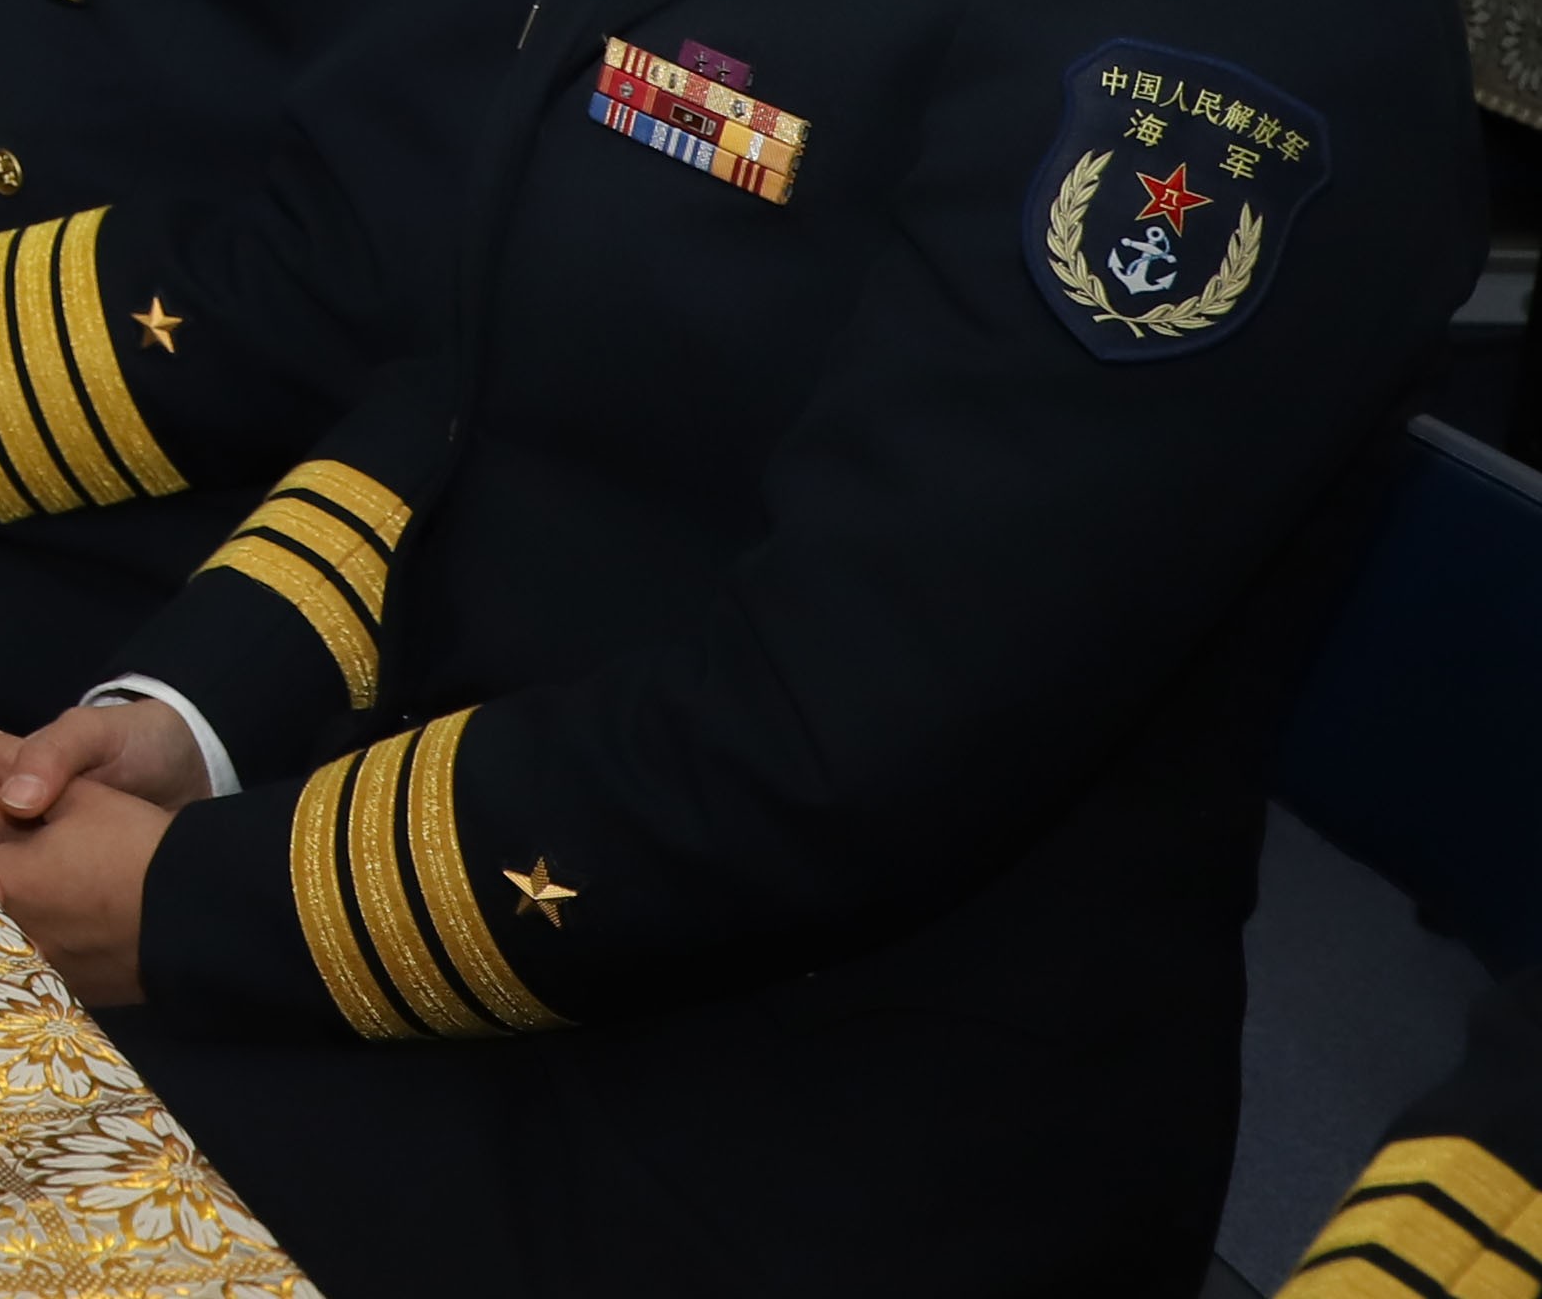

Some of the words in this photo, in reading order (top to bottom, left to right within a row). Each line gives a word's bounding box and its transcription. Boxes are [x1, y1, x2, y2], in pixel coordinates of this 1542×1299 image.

[1101, 65, 1312, 164] 中国人民解放军
[1123, 108, 1261, 180] 海军
